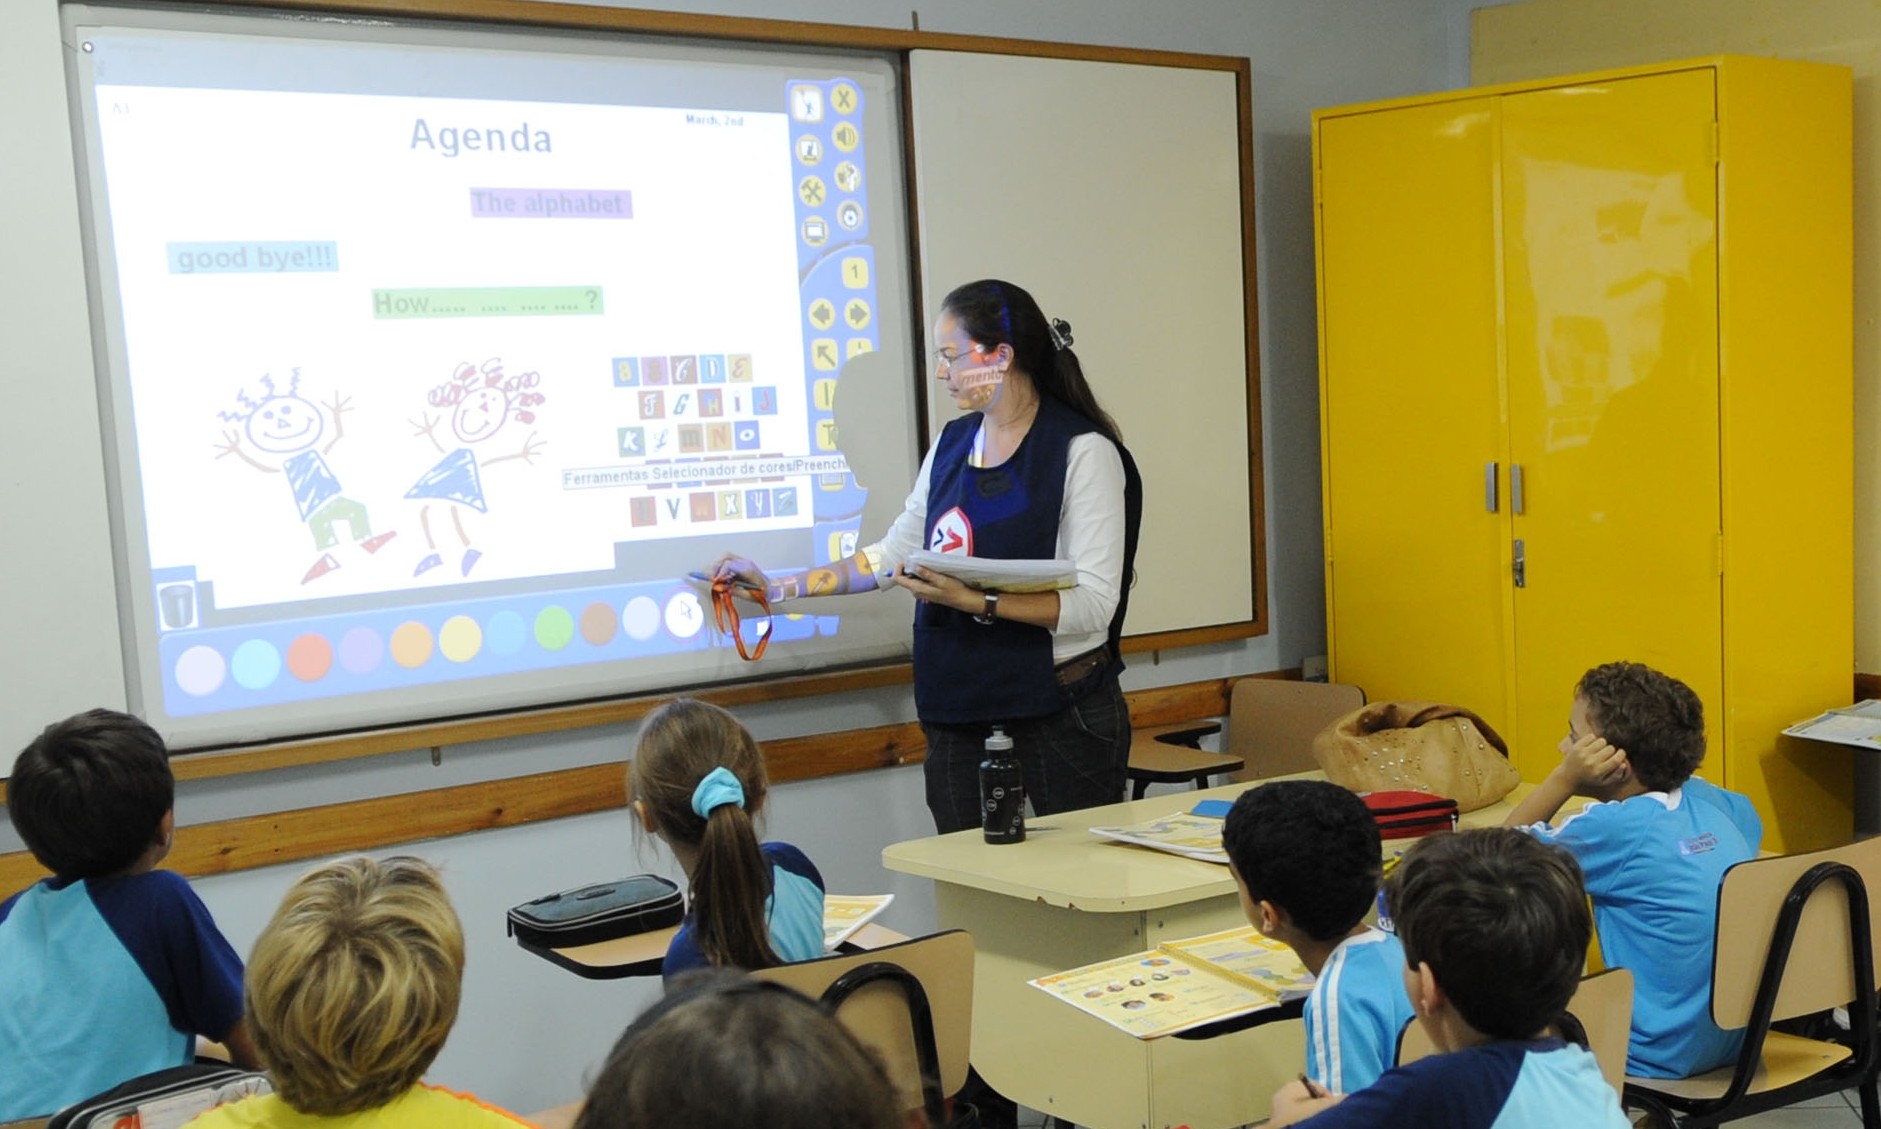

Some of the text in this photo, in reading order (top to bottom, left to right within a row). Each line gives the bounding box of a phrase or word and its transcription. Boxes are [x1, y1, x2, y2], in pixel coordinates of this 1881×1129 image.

[686, 114, 744, 128] March, 2nd
[410, 118, 553, 157] Agenda
[472, 191, 623, 217] The alphabet
[178, 246, 332, 274] good bye!!!
[563, 469, 648, 487] Ferramentas
[652, 464, 737, 481] Selecionador
[740, 461, 755, 475] de
